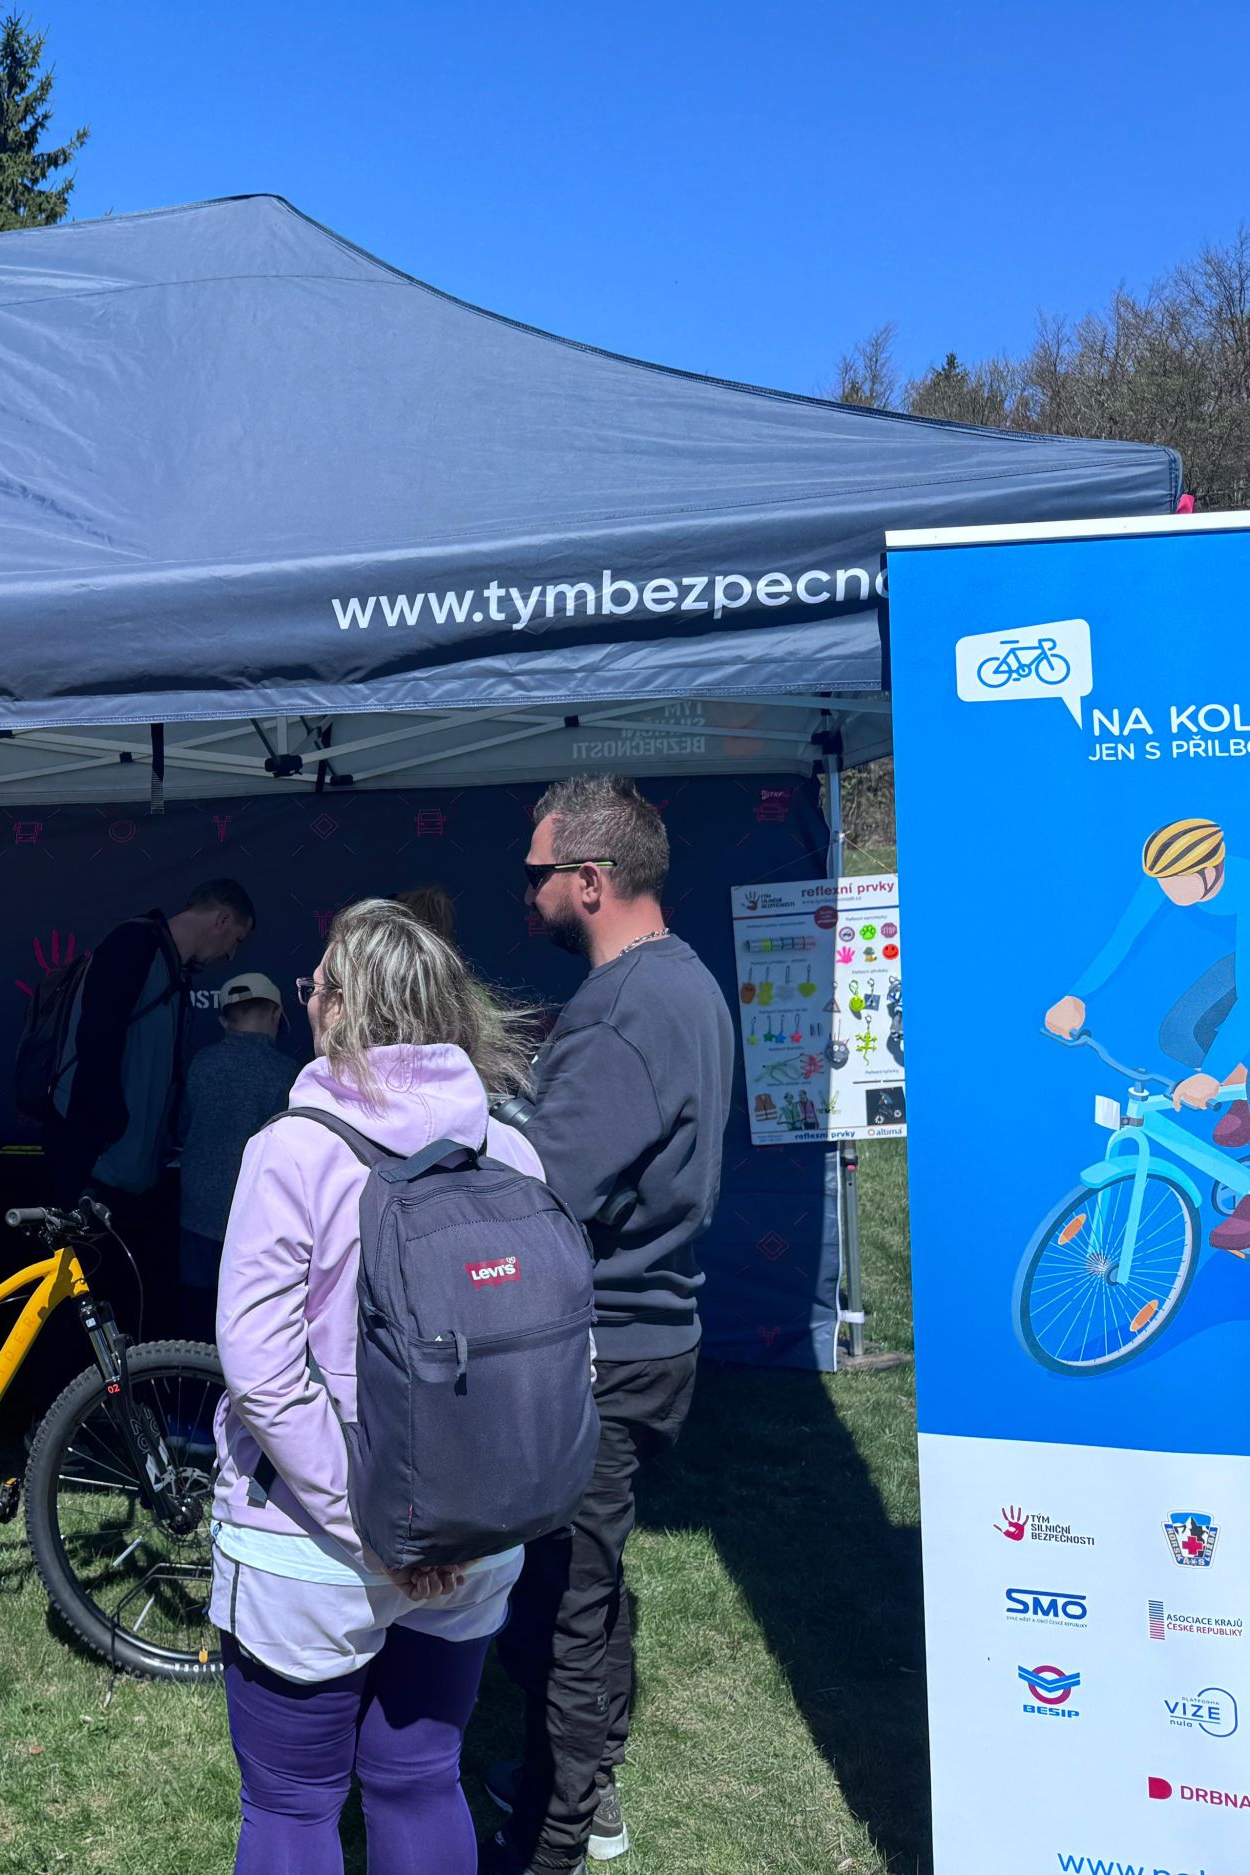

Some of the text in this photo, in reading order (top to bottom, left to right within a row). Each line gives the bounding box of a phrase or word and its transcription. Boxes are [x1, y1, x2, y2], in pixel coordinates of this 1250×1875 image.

[1092, 707, 1153, 736] NA
[1088, 735, 1250, 761] JEN S PŘILB
[801, 881, 895, 898] reflexní prvky
[831, 1130, 856, 1139] prvky
[1031, 1513, 1050, 1524] TÝM
[1031, 1523, 1071, 1534] SILNIČNÍ
[1031, 1532, 1095, 1545] BEZPEČNOSTI
[1005, 1588, 1087, 1620] SMO
[1166, 1614, 1243, 1628] ASOCIACE KRAJŮ
[1166, 1622, 1243, 1636] ČESKÉ REPUBLIKY
[1023, 1704, 1080, 1718] BESIP
[1164, 1700, 1220, 1720] VIZE
